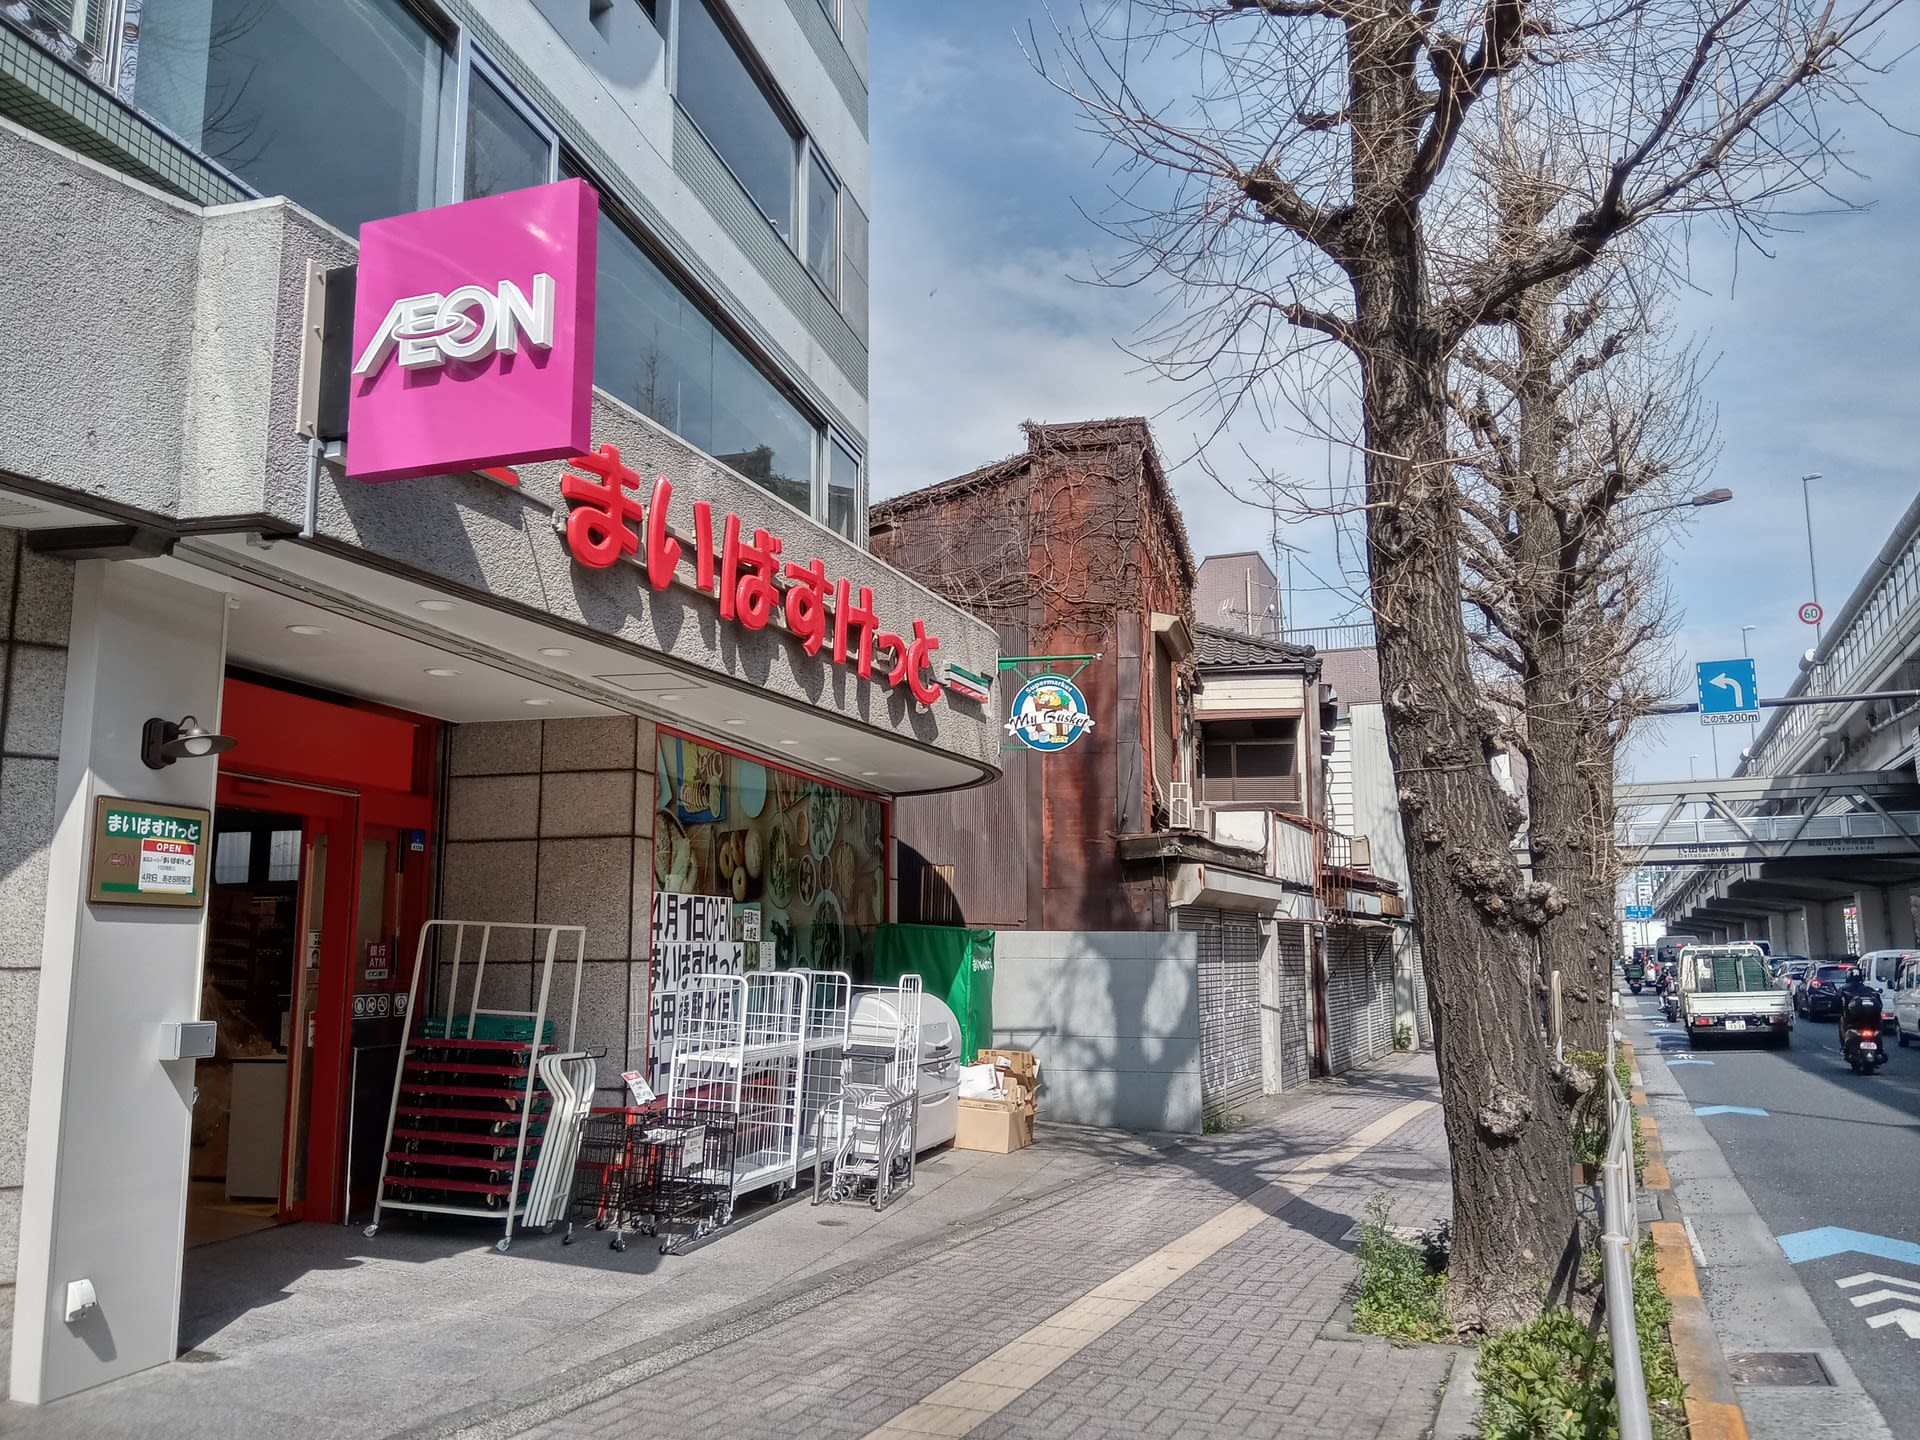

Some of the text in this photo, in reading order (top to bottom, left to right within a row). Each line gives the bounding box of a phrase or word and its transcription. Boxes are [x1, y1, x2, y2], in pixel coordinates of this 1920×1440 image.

[560, 443, 941, 706] まいばすけっと
[1804, 608, 1818, 619] 60
[1026, 680, 1073, 694] Supermarket
[1010, 710, 1089, 727] My Basket
[1703, 713, 1758, 725] この先200m
[108, 815, 199, 840] まいばすけっと
[156, 843, 182, 853] OPEN
[653, 893, 731, 941] 4月1日OPEN
[370, 945, 387, 956] 銀行
[369, 957, 386, 968] ATM
